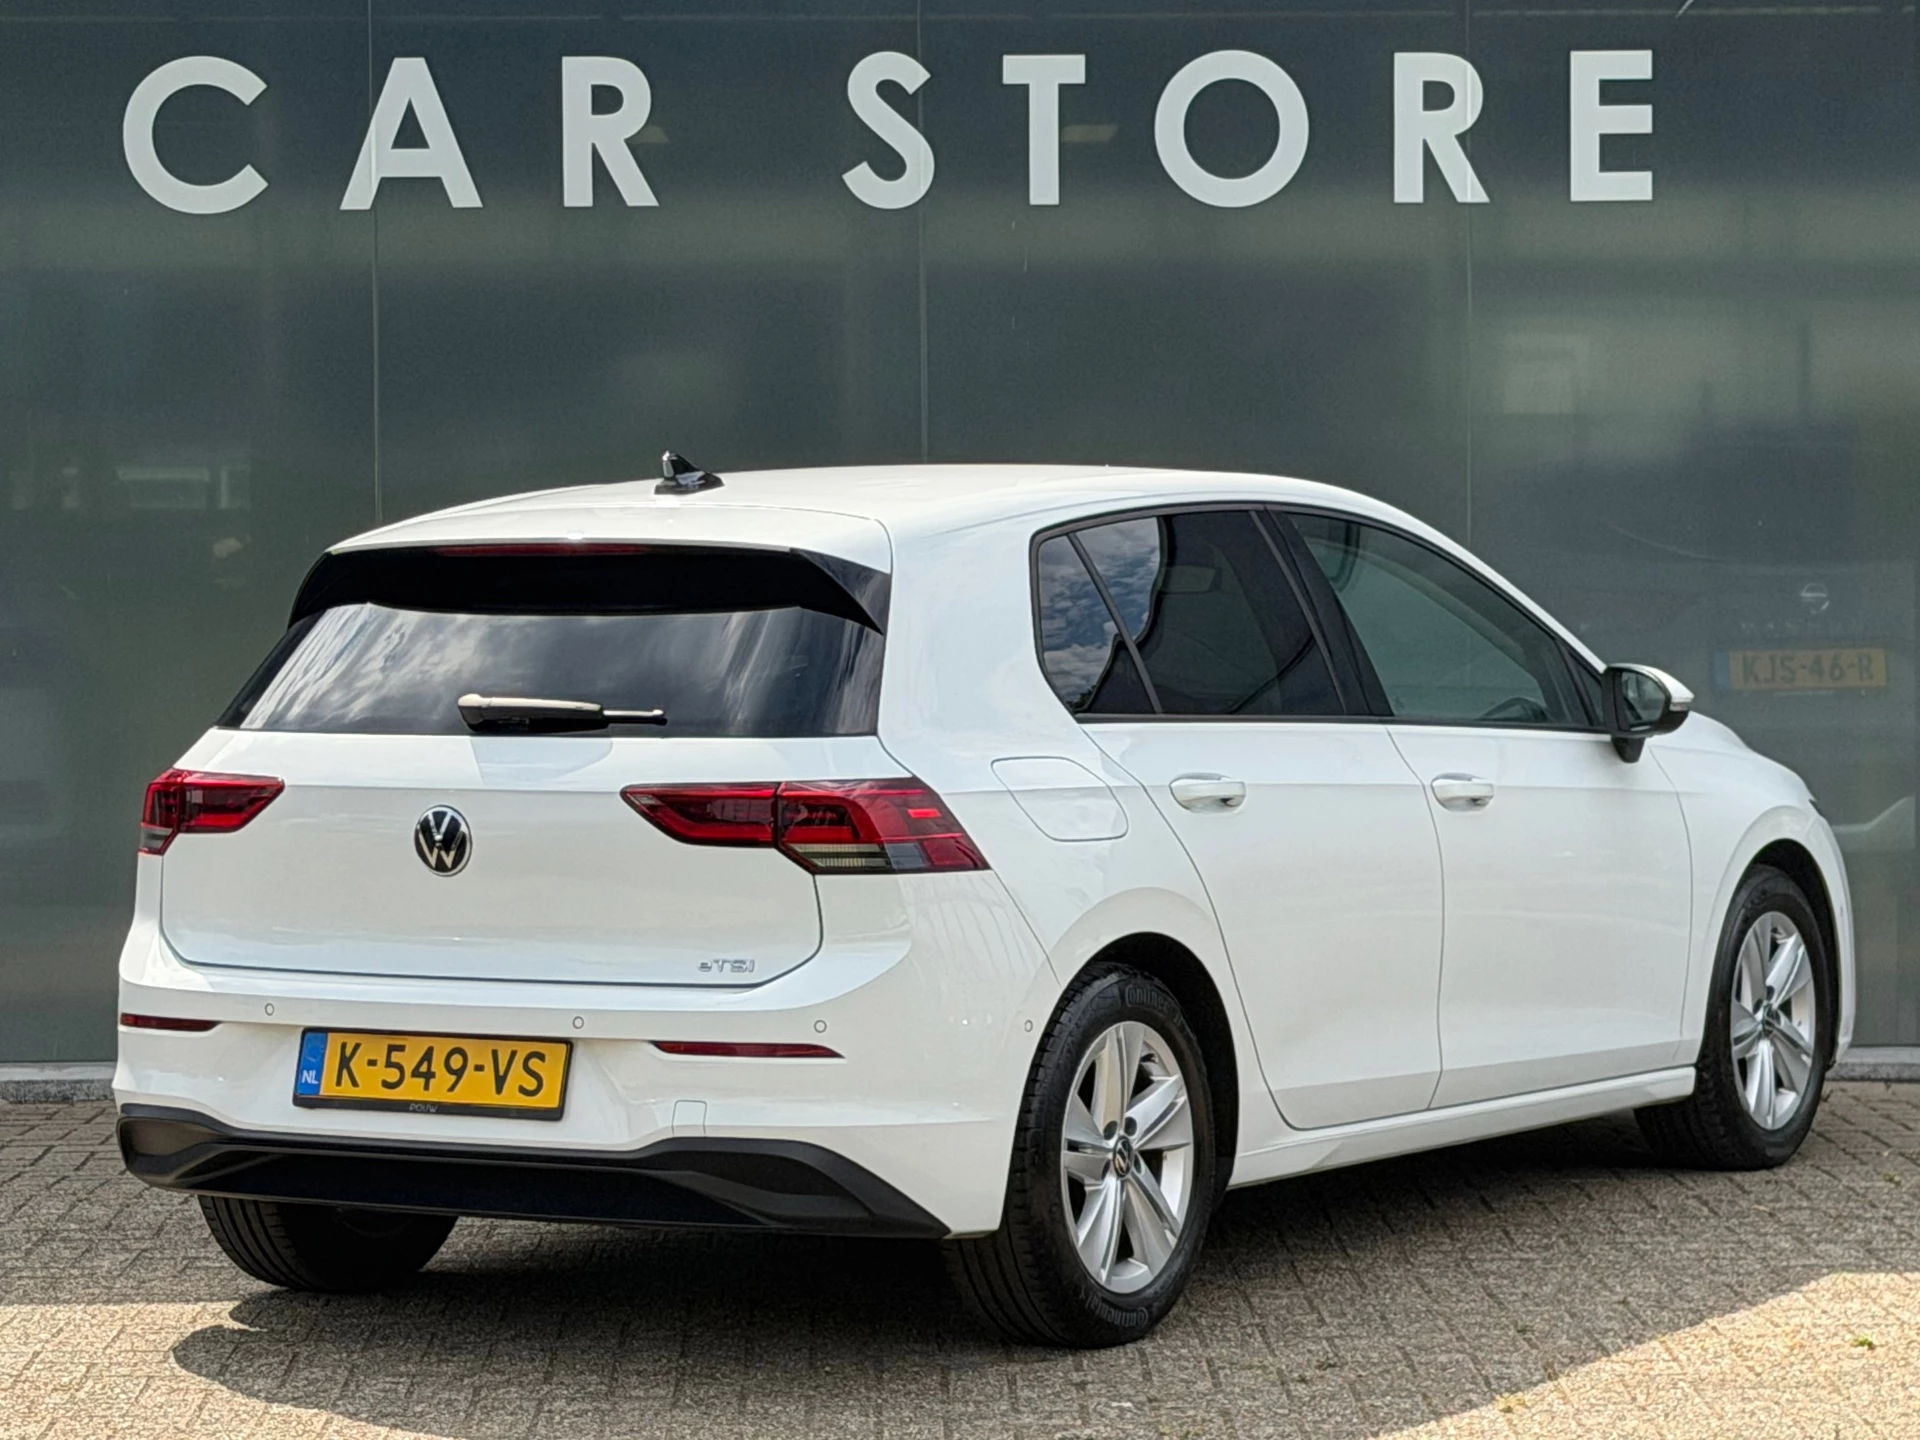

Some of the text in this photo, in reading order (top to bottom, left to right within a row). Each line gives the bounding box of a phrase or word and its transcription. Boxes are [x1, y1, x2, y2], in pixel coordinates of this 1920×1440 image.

[123, 50, 1653, 213] CAR STORE
[698, 959, 755, 973] eTSI
[302, 1070, 319, 1084] NL
[335, 1041, 546, 1097] K-549-VS
